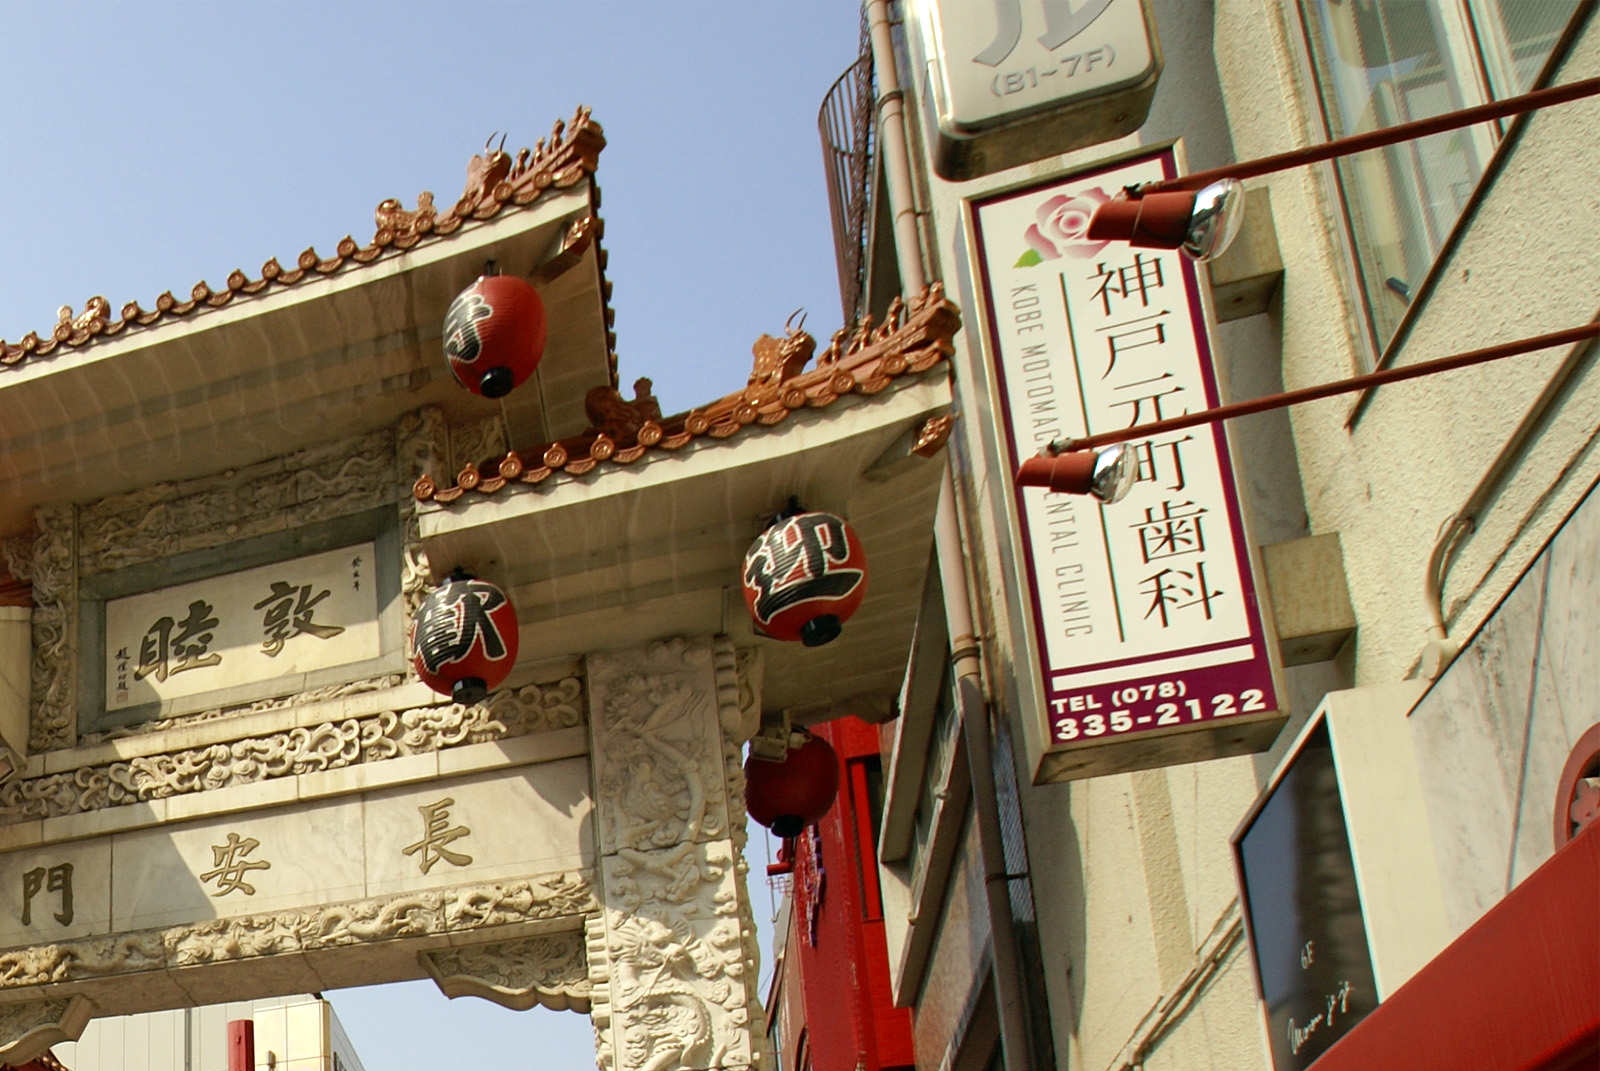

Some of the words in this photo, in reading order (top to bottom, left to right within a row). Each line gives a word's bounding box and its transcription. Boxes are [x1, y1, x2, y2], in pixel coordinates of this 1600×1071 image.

[1011, 283, 1044, 336] KOBE
[1021, 343, 1065, 450] MOTOMAC
[1084, 252, 1225, 628] 神戸元町歯科
[1055, 563, 1093, 638] CLINIC
[1051, 694, 1102, 714] TEL
[1111, 680, 1187, 707] (078)
[1055, 688, 1267, 741] 335-2122
